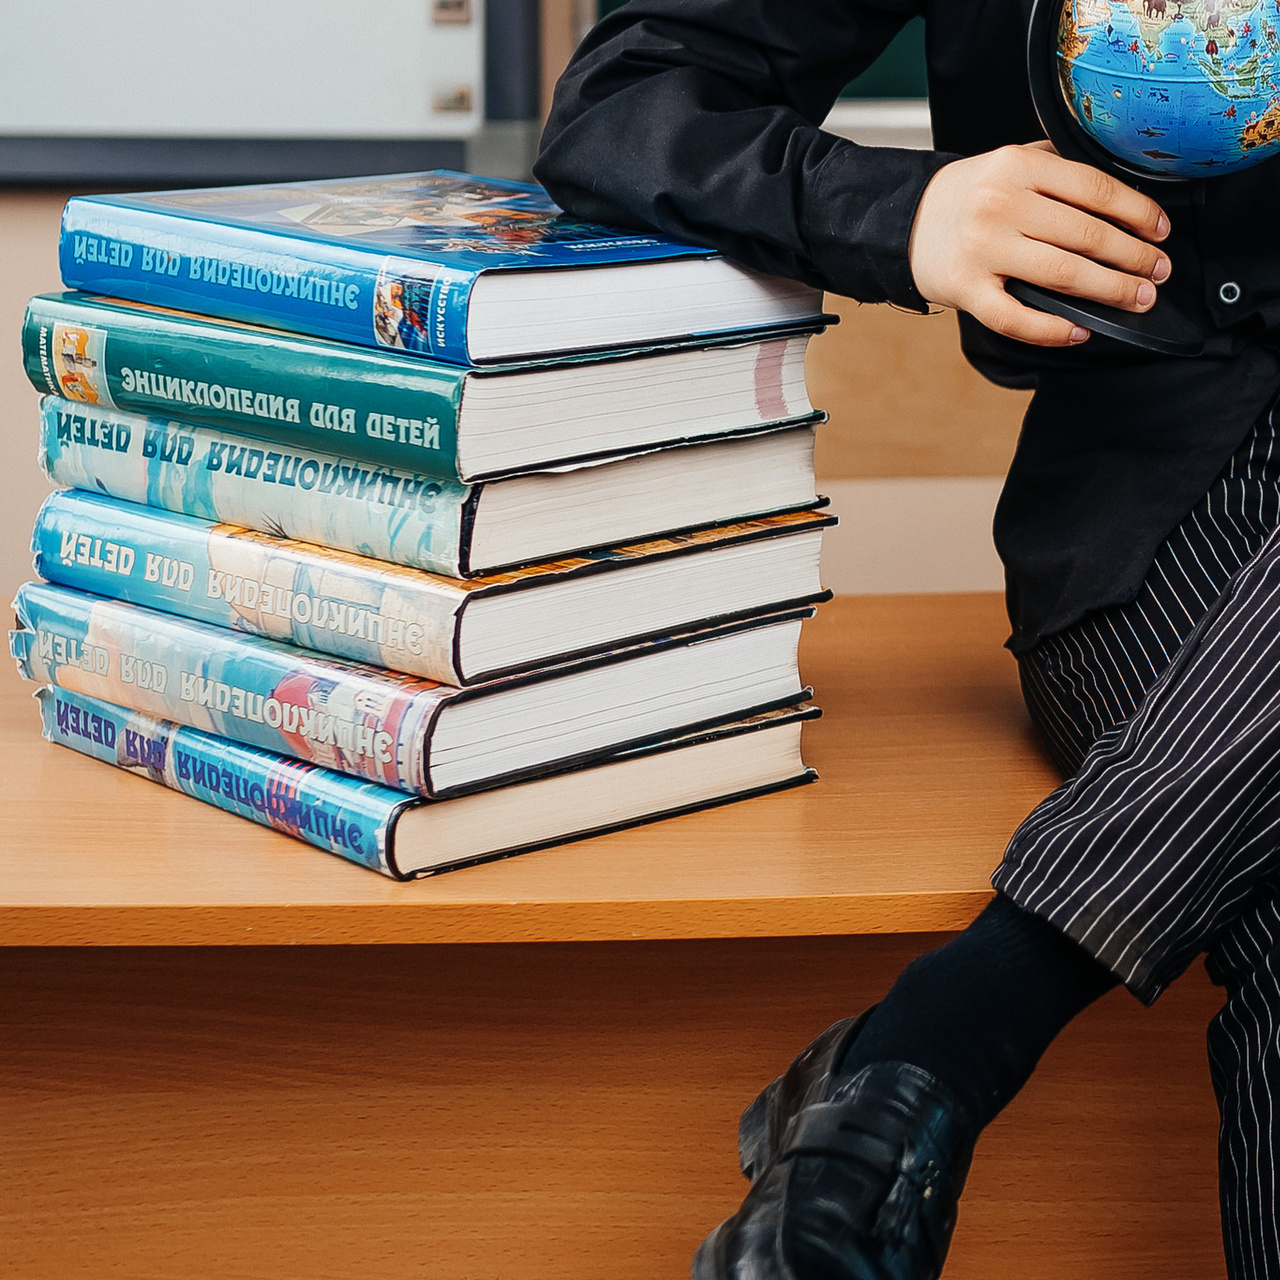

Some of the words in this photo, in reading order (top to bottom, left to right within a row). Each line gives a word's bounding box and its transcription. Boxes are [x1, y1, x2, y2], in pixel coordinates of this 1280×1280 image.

[73, 233, 133, 267] ДЕТЕЙ
[140, 241, 181, 276] ДЛЯ
[188, 252, 359, 310] ЭНЦИКЛОПЕДИЯ
[435, 276, 453, 348] ИСКУССТВО
[56, 411, 131, 453] ДЕТЕЙ
[120, 367, 301, 425] ЭНЦИКЛОПЕДИЯ
[309, 402, 356, 436] ДЛЯ
[366, 411, 441, 451] ДЕТЕЙ
[142, 428, 195, 467] ДЛЯ
[206, 440, 443, 514] ЭНЦИКЛОПЕДИЯ
[59, 529, 135, 578] ДЕТЕЙ
[144, 552, 195, 592] ДЛЯ
[206, 568, 426, 656] ЭНЦИКЛОПЕДИЯ
[36, 628, 110, 678] ДЕТЕЙ
[119, 652, 168, 694] ДЛЯ
[55, 698, 116, 750] ДЕТЕЙ
[179, 671, 394, 765] ЭНЦИКЛОПЕДИЯ
[125, 727, 167, 771] ДЛЯ
